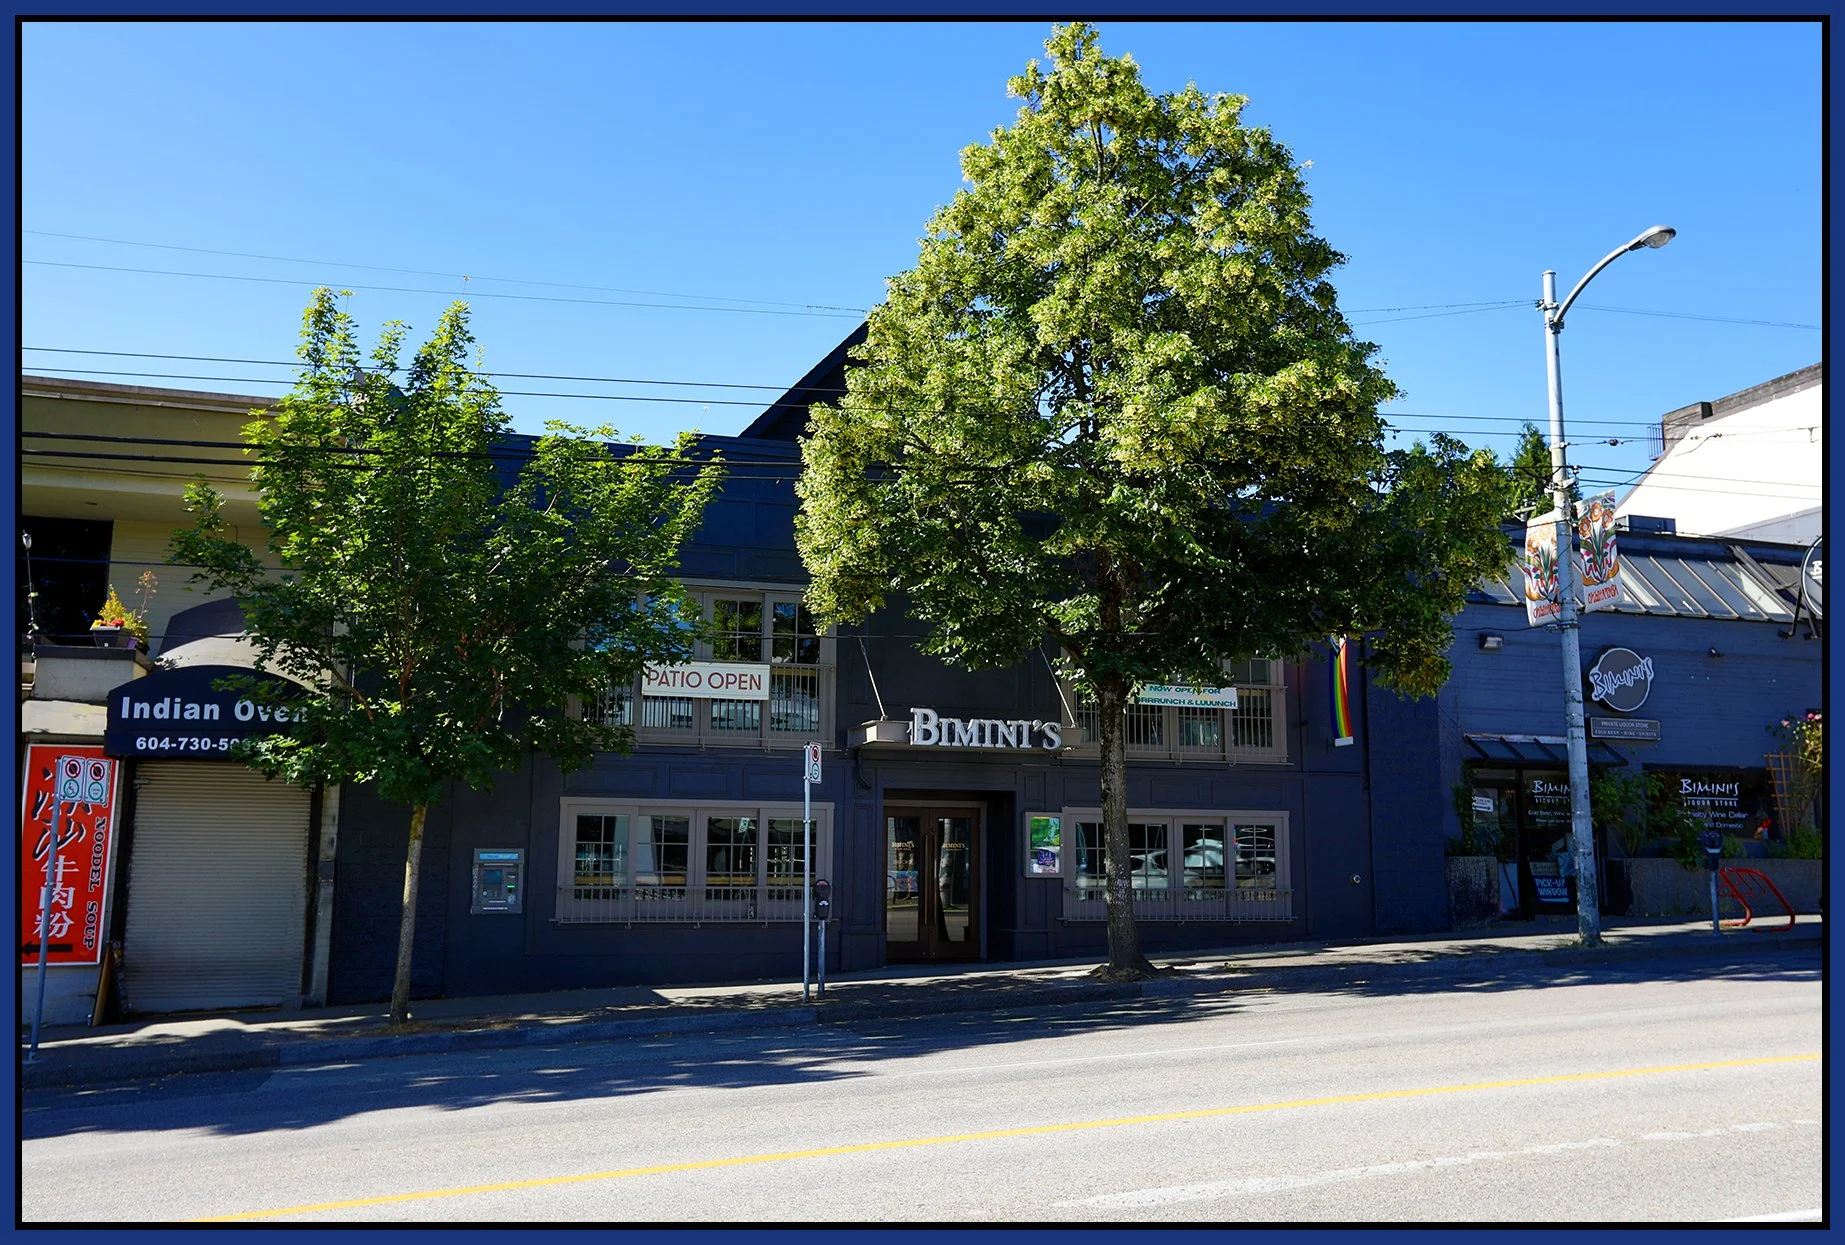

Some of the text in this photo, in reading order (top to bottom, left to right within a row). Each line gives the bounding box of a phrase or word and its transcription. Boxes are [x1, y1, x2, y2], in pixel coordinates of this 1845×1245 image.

[647, 669, 761, 690] PATIO OPEN
[1149, 685, 1172, 693] NOW
[121, 696, 309, 723] Indian Oven
[910, 707, 1062, 750] BIMINI'S
[1679, 779, 1739, 796] BIMINI'S
[88, 816, 107, 892] NOODEL
[1535, 878, 1565, 888] PICK-UP
[1538, 888, 1568, 896] WINDOW
[83, 901, 99, 950] SOUP
